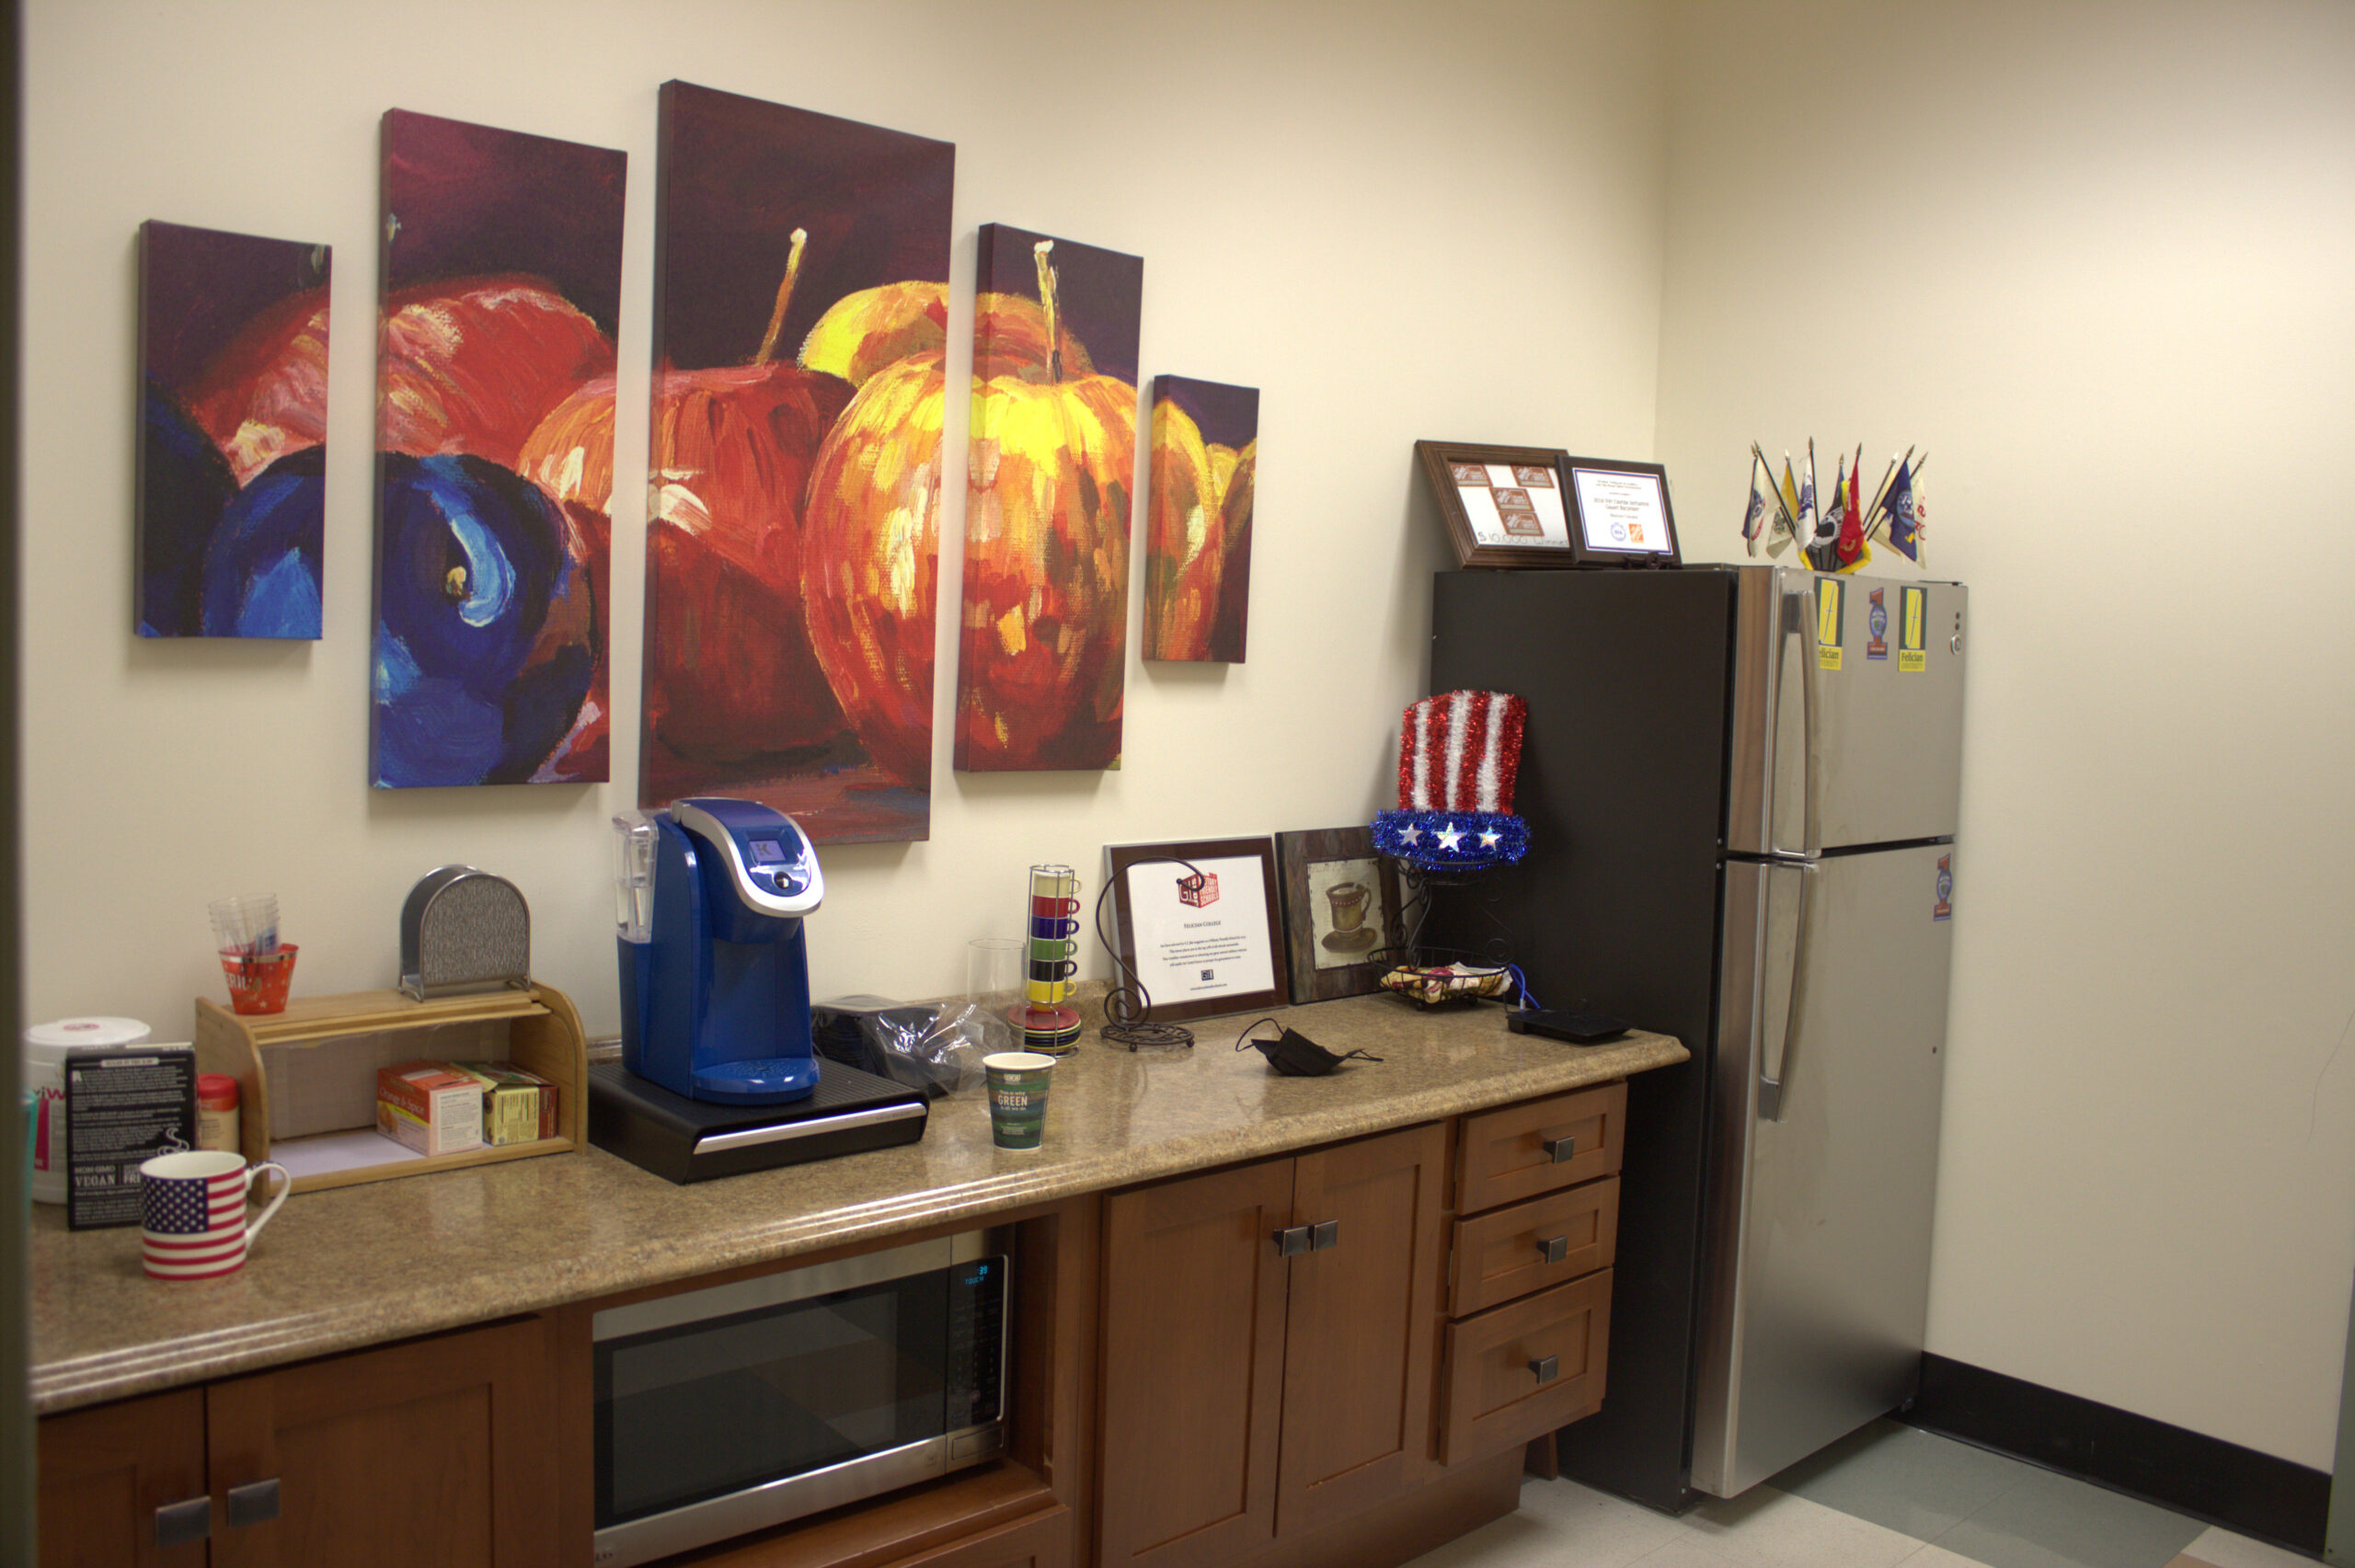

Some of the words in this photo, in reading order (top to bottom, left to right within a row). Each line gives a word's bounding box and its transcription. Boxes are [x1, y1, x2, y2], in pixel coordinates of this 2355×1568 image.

[1901, 652, 1924, 662] Felician
[379, 1087, 400, 1104] Orange
[407, 1099, 425, 1115] Spice
[997, 1094, 1028, 1107] GREEN
[75, 1173, 117, 1186] VEGAN
